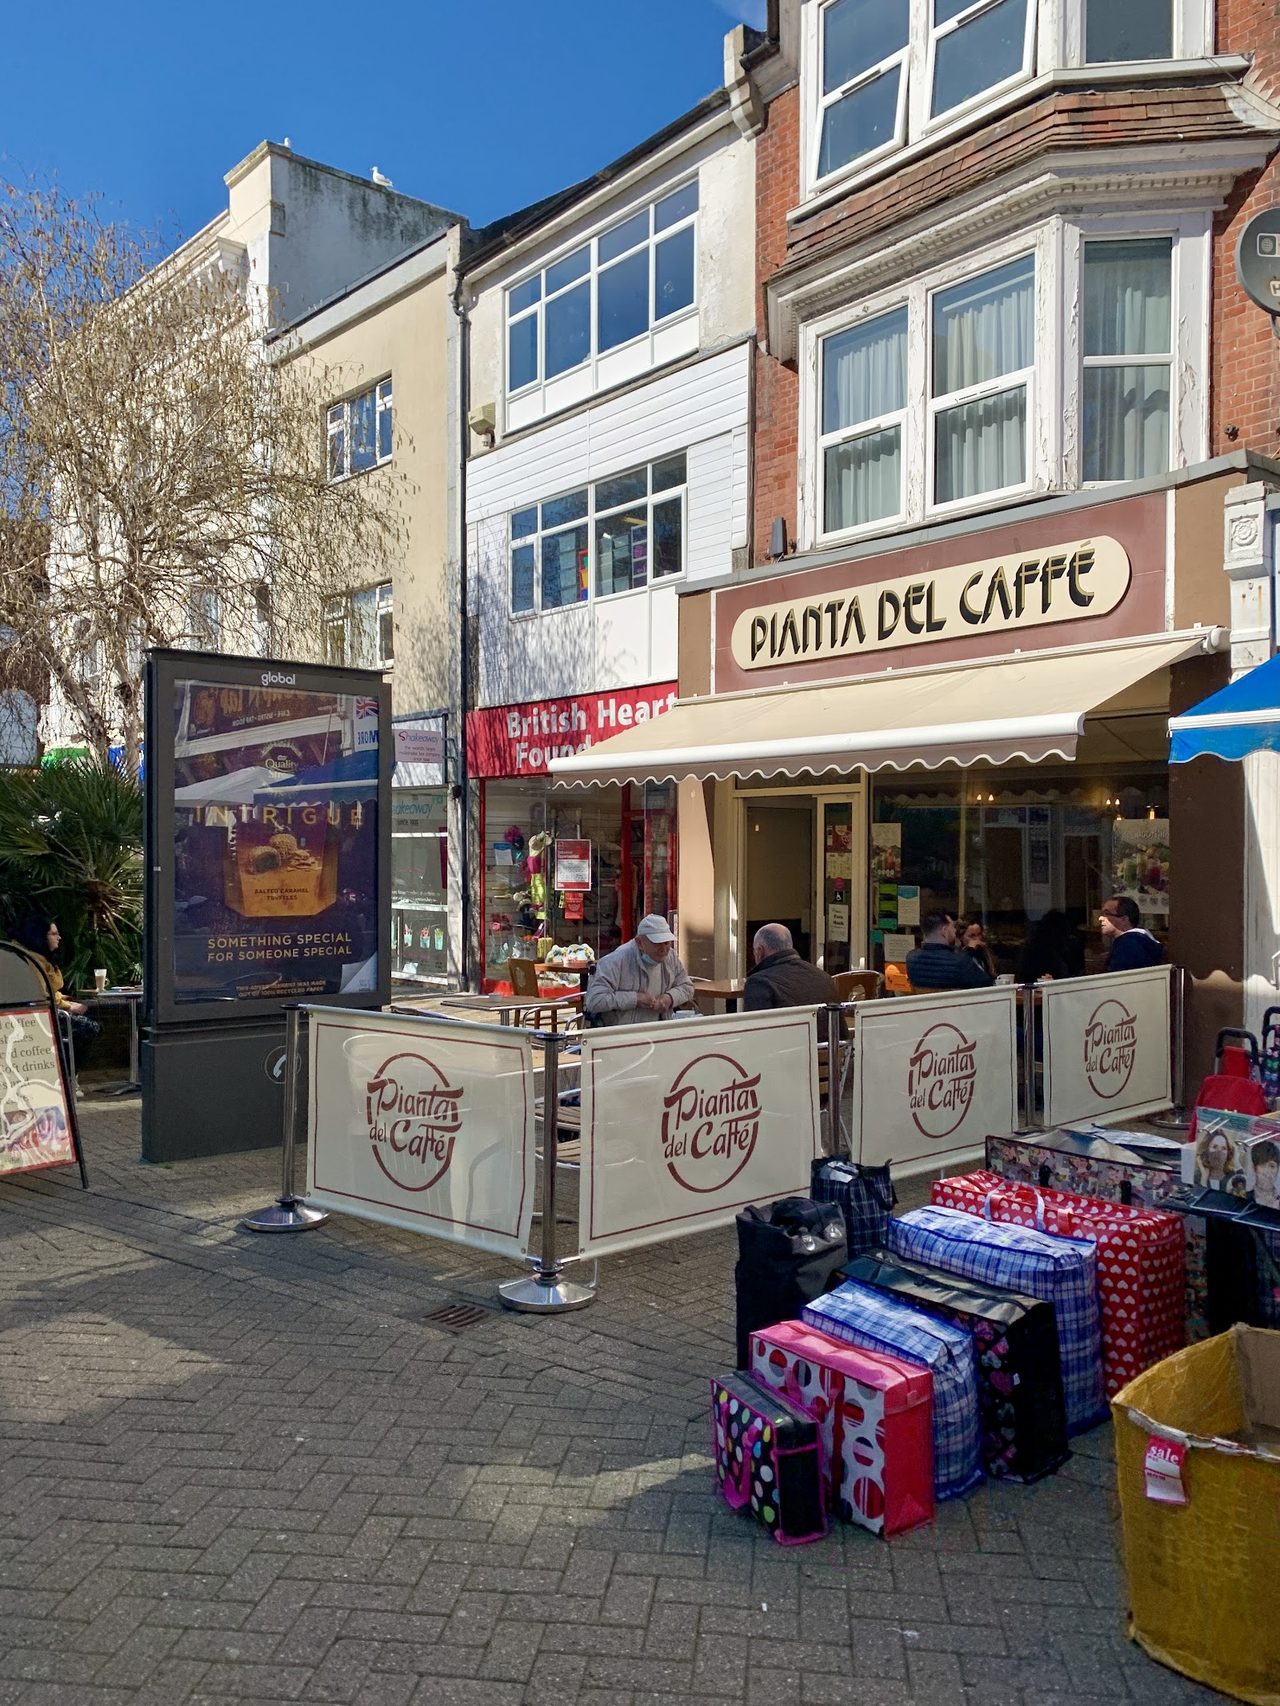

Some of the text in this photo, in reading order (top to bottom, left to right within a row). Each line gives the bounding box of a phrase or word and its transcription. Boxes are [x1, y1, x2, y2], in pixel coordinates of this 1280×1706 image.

[750, 540, 1095, 662] PIANTA DEL CAFFÉ
[261, 672, 296, 686] global
[506, 691, 677, 739] British Heart
[194, 805, 365, 826] INTRIGUE
[208, 932, 352, 949] SOMETHING SPECIAL
[208, 946, 352, 962] FOR SOMEONE SPECIAL
[1085, 1014, 1137, 1052] Pianta
[20, 1047, 51, 1058] coffee
[22, 1060, 55, 1072] drinks
[909, 1041, 977, 1084] Pianta
[1086, 1038, 1137, 1074] del Caffé
[367, 1078, 464, 1120] Pianta
[664, 1073, 761, 1130] Pianta
[910, 1068, 977, 1111] del Caffé
[369, 1119, 463, 1164] del Caffé
[664, 1106, 762, 1159] del Caffé
[1150, 1446, 1179, 1464] sale
